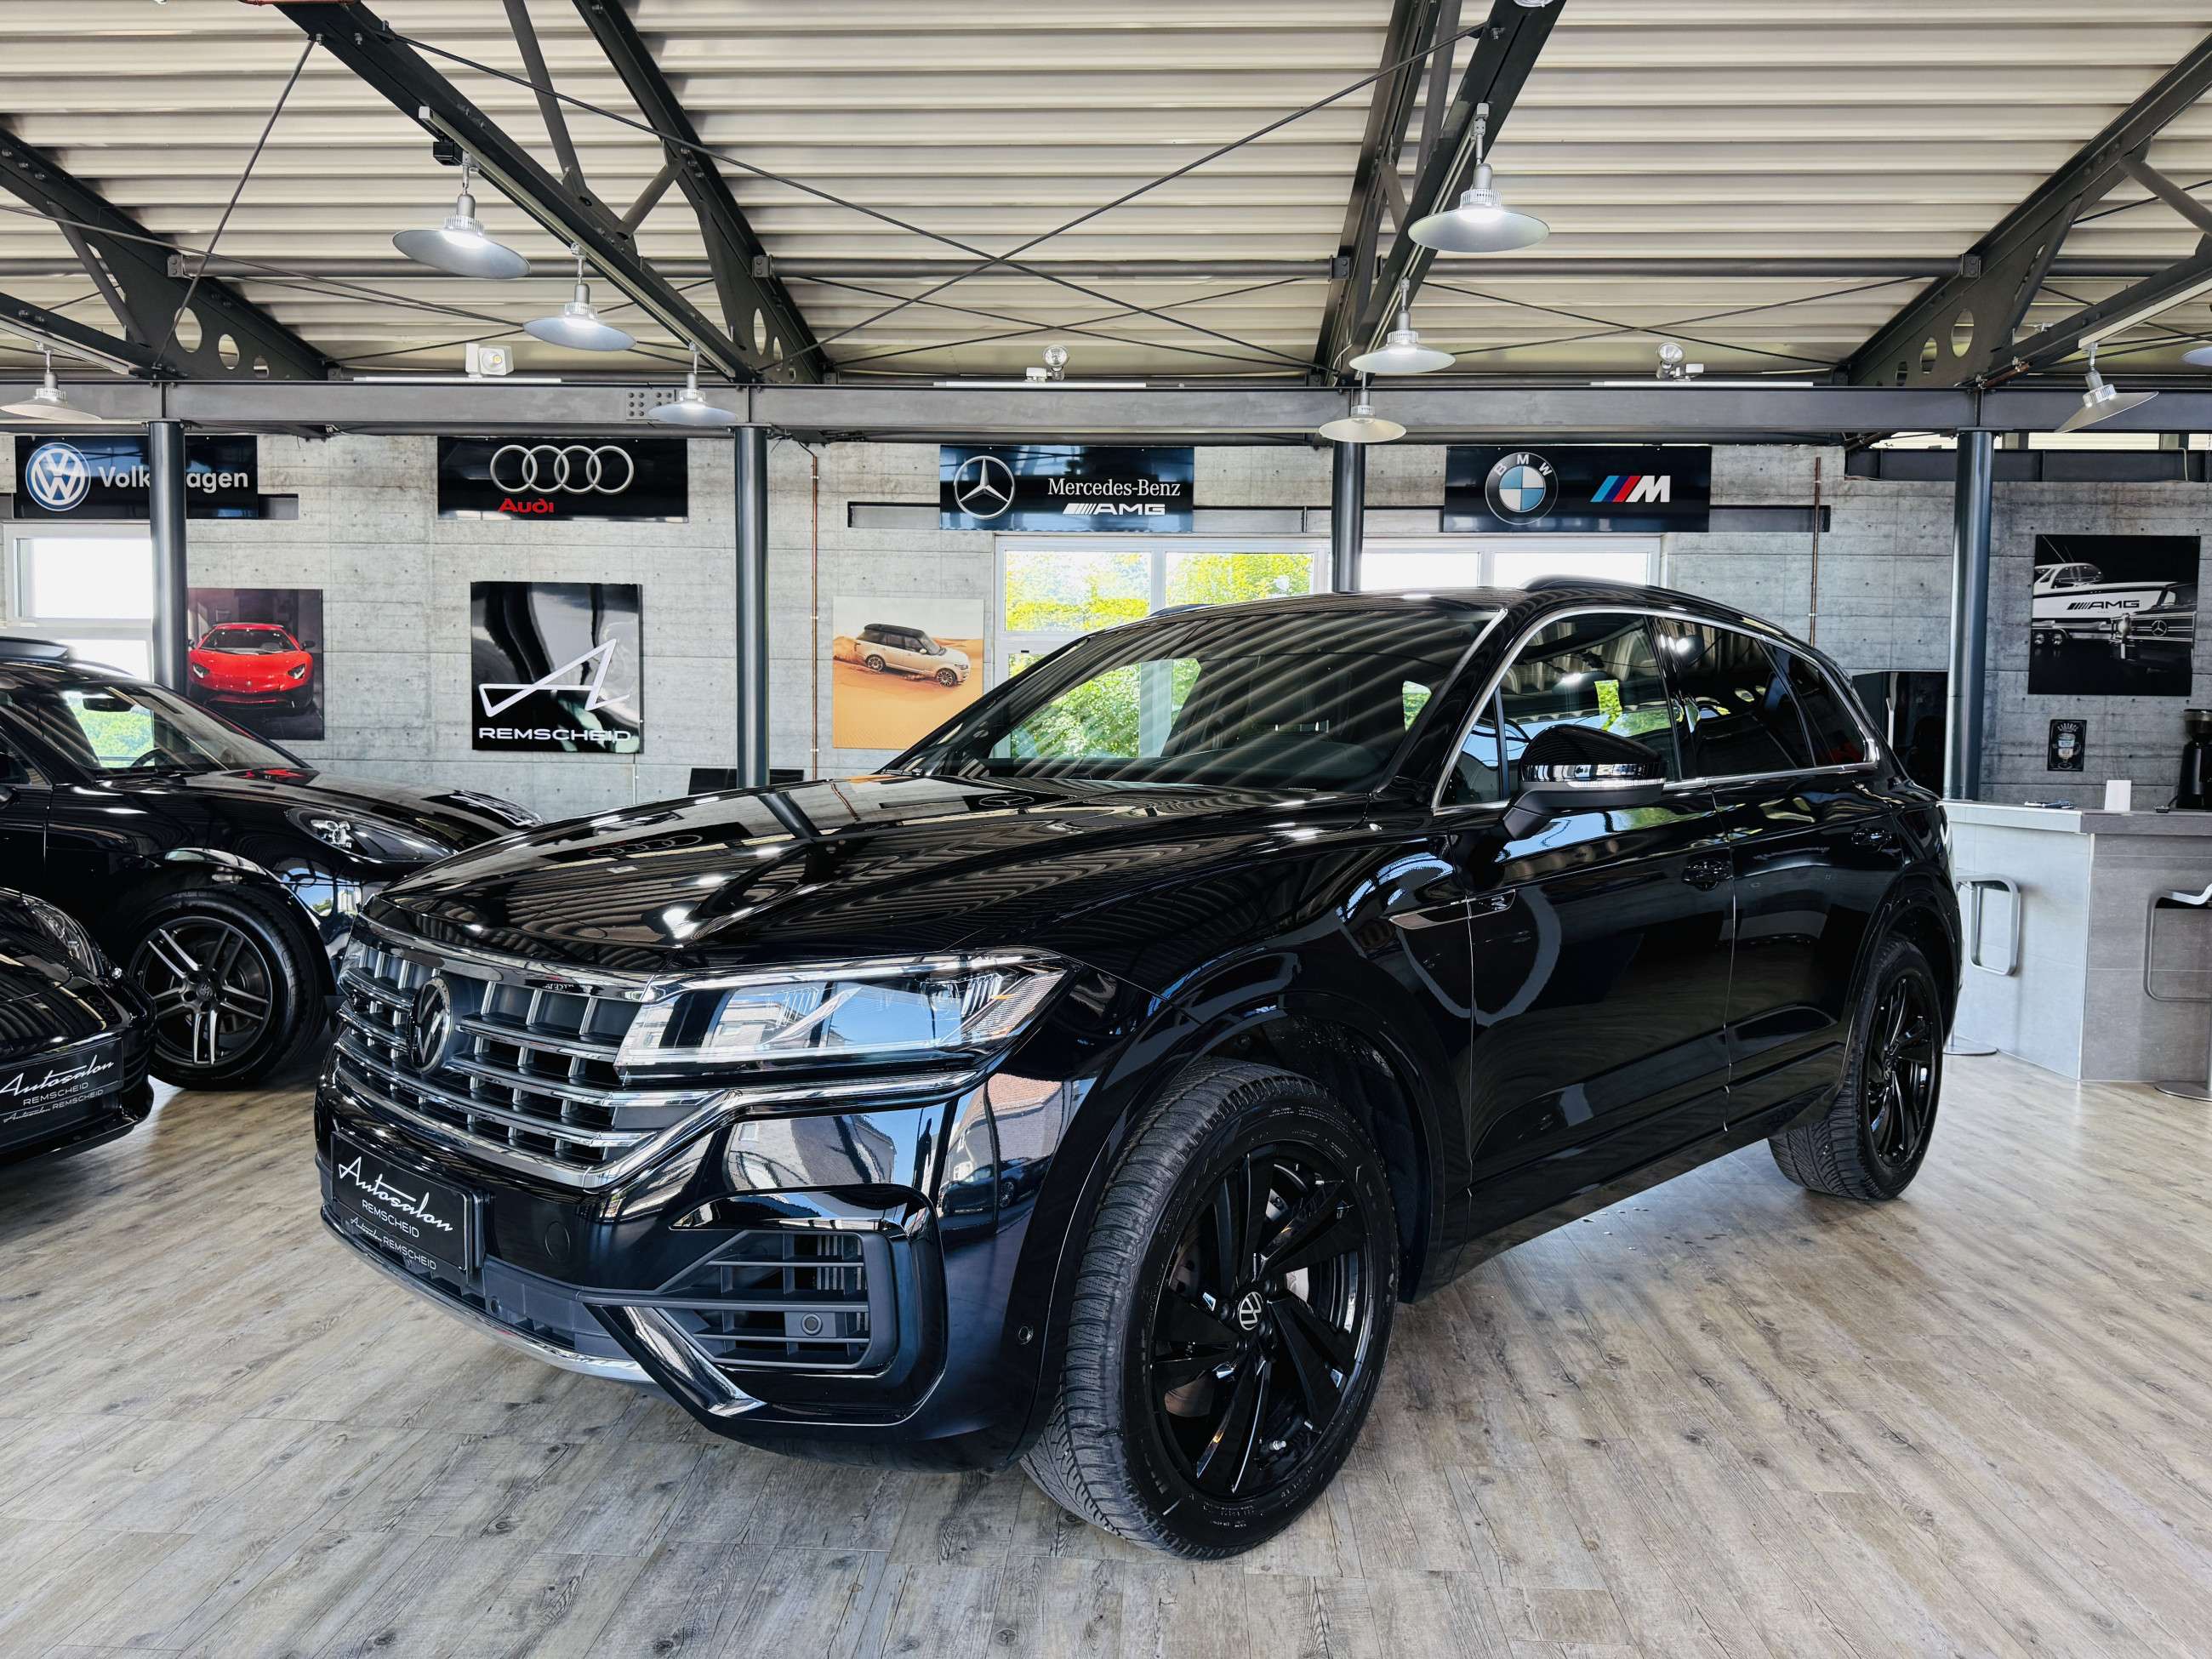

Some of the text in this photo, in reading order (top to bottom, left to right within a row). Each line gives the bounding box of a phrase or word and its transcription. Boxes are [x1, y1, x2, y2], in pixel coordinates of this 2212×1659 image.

[1495, 453, 1553, 477] BMW
[98, 465, 248, 493] Volkagen
[1047, 477, 1181, 497] Mercedes-Benz
[1626, 475, 1671, 503] M
[499, 499, 555, 514] Audi
[1093, 503, 1166, 516] AMG
[2088, 600, 2140, 609] AMG
[479, 727, 631, 742] REMSCHEID
[0, 1054, 114, 1096] Autosalon
[3, 1089, 104, 1124] Autosalon REMSCHEID
[22, 1081, 89, 1106] REMSCHEID
[338, 1156, 453, 1232] Autosalon
[361, 1198, 419, 1239] REMSCHEID
[382, 1235, 436, 1271] REMSCHEID
